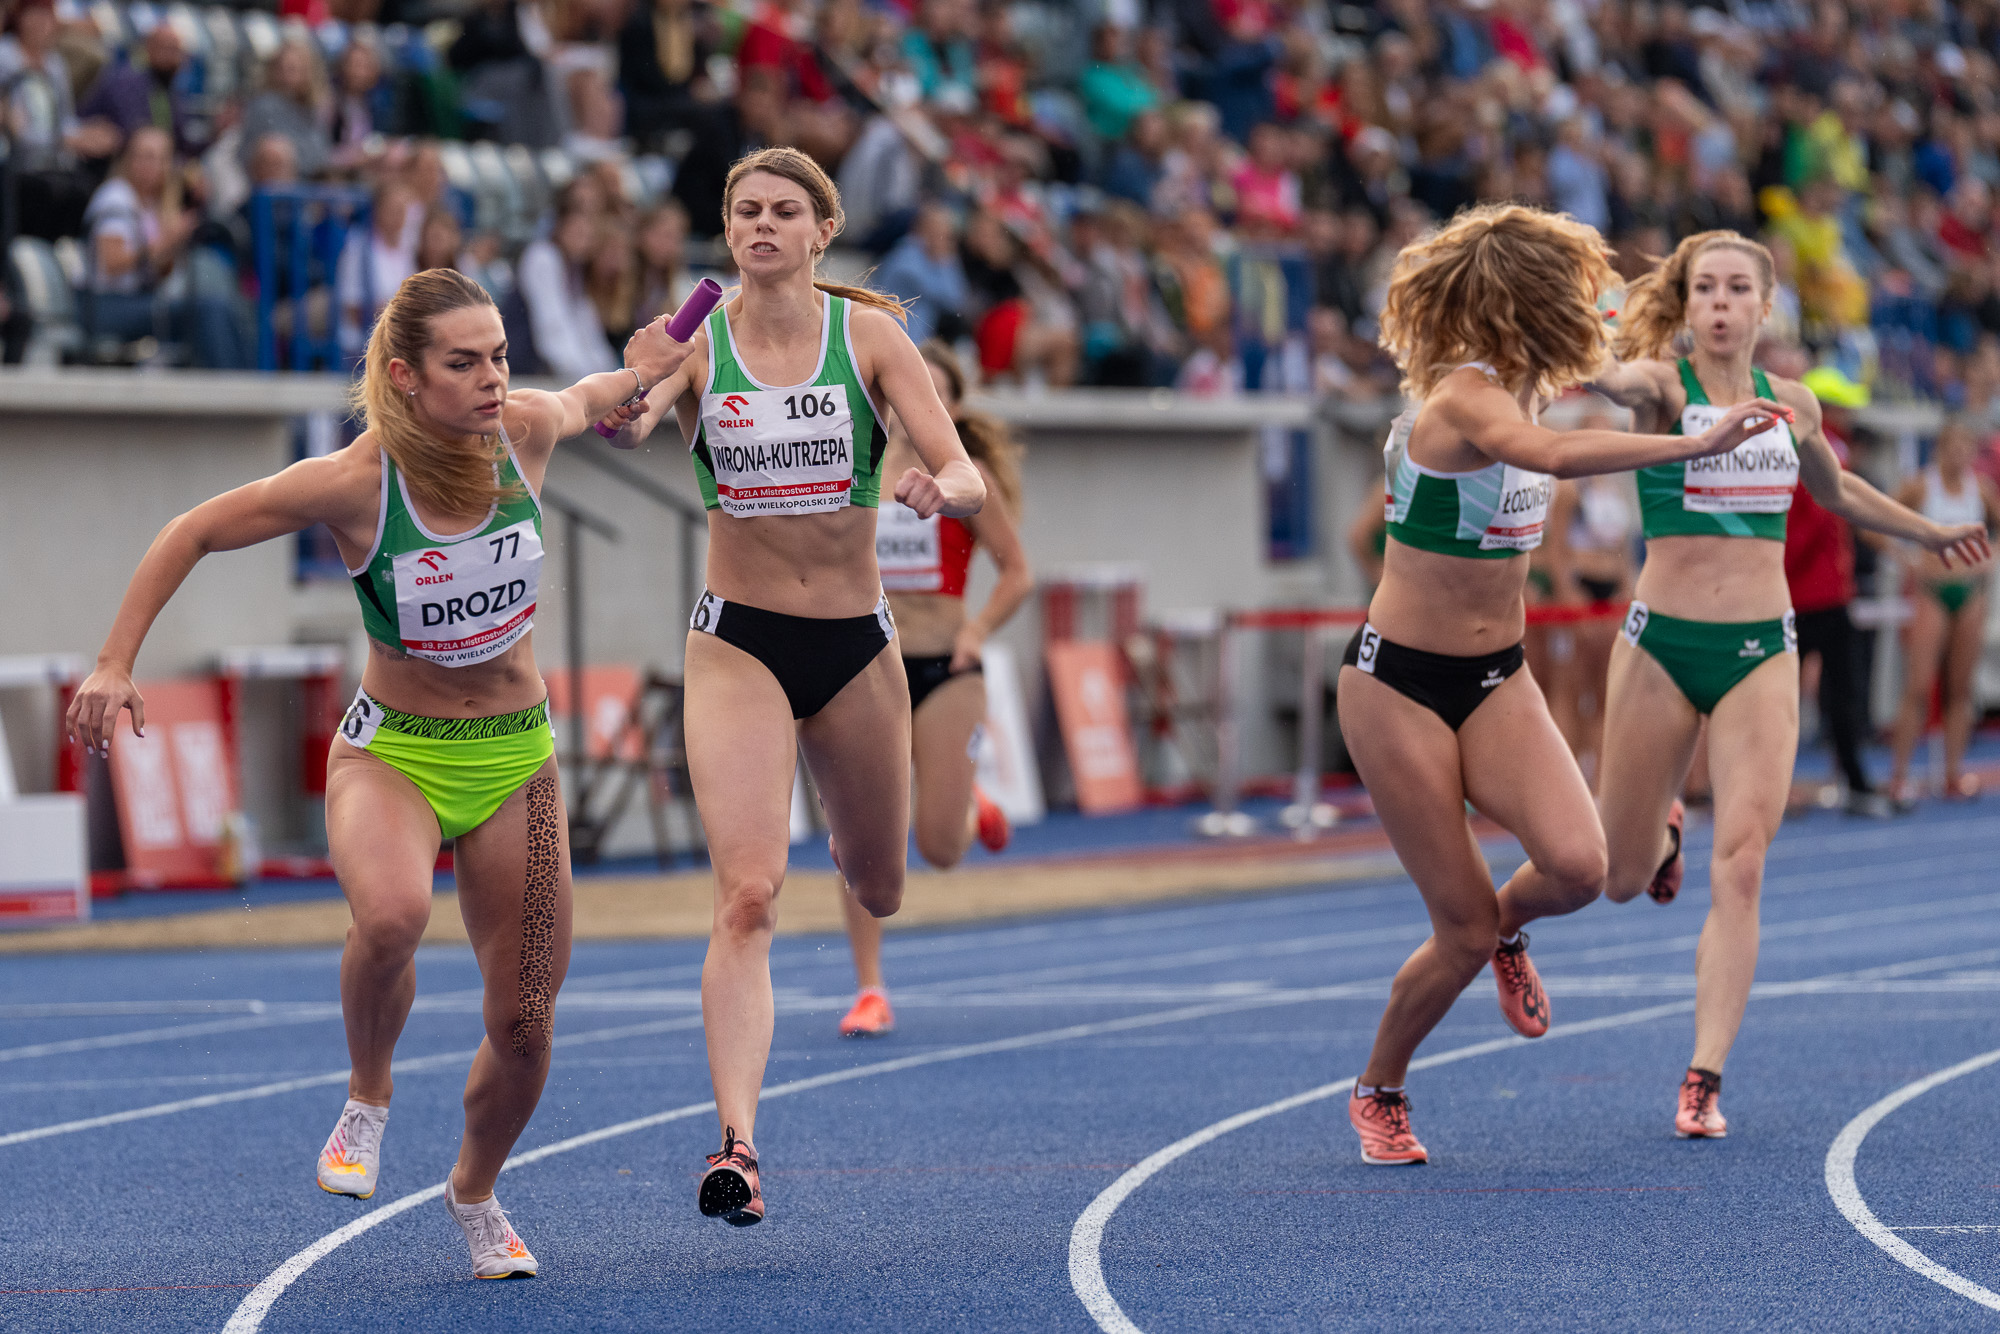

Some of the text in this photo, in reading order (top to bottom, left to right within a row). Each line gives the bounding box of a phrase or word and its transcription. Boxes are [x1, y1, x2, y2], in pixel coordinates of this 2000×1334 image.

[784, 392, 836, 420] 106
[718, 419, 754, 429] ORLEN
[713, 437, 848, 473] WRONA-KUTRZEPA
[738, 489, 759, 498] PZLA
[760, 485, 811, 497] Mistrzostwa
[813, 482, 839, 492] Polski
[757, 498, 827, 510] WIELKOPOLSKI
[489, 531, 520, 565] 77
[415, 572, 454, 586] ORLEN
[421, 579, 527, 627] DROZD
[693, 589, 714, 632] 6
[421, 642, 436, 651] 99.
[437, 641, 459, 650] PZLA
[460, 627, 508, 647] Mistrzostwa
[507, 612, 526, 630] Polski
[1627, 609, 1646, 636] 5
[457, 632, 517, 661] WIELKOPOLSKI
[1359, 632, 1378, 662] 5
[343, 698, 371, 740] 6
